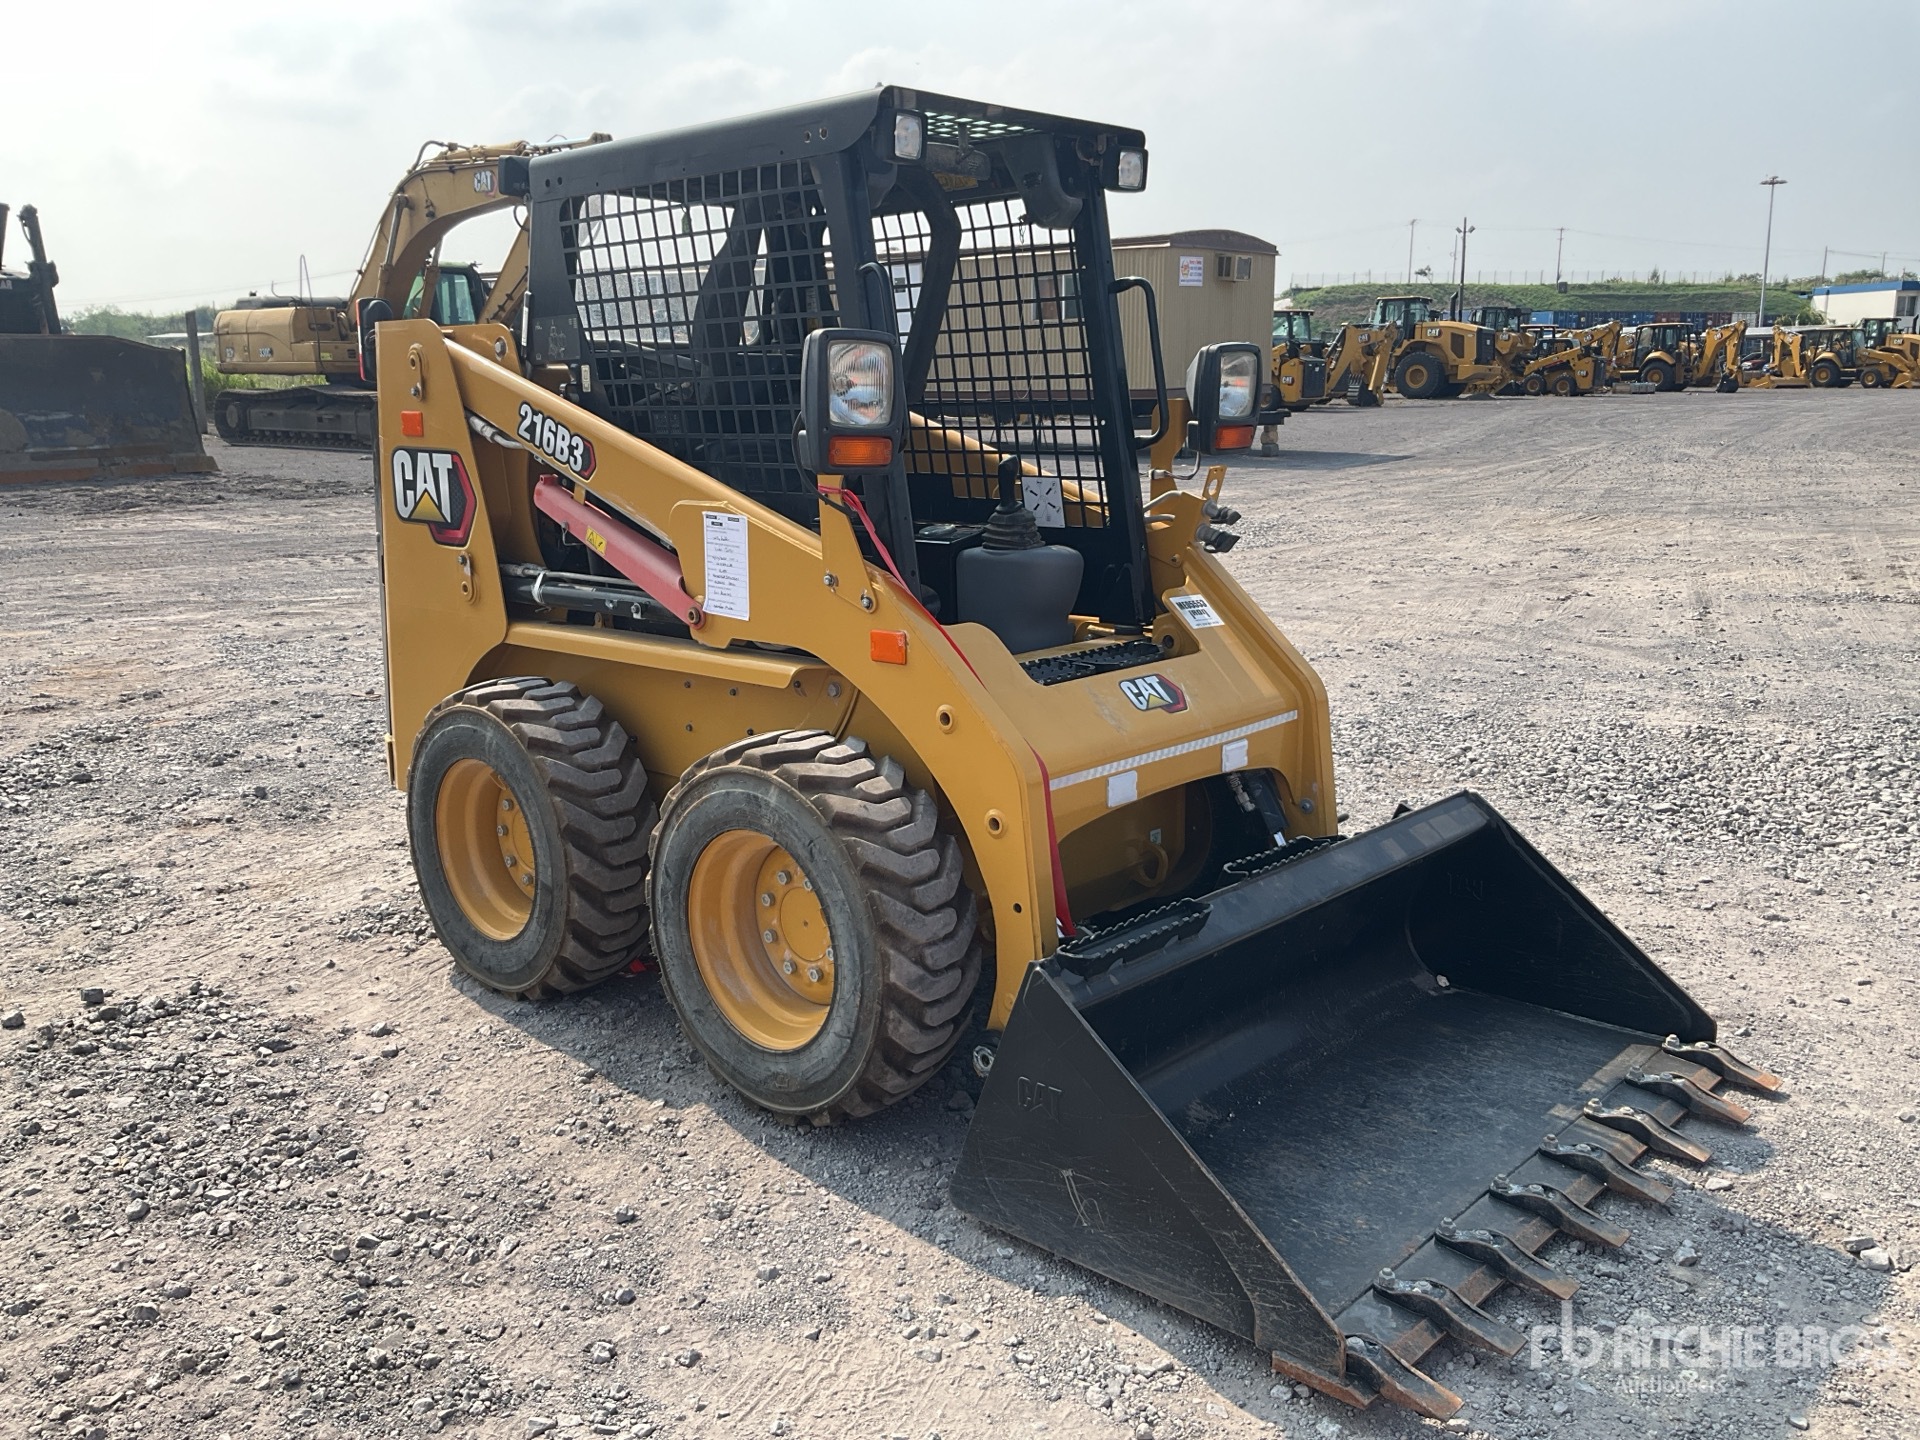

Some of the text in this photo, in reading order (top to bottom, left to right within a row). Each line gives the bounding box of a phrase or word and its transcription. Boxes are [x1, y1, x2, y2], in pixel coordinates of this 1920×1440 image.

[474, 170, 492, 193] CAT
[1427, 328, 1440, 337] CAT
[1282, 376, 1293, 384] CAT
[517, 402, 584, 473] 216B3
[393, 450, 453, 523] CAT
[1119, 676, 1173, 711] CAT
[1017, 1076, 1062, 1123] CAT
